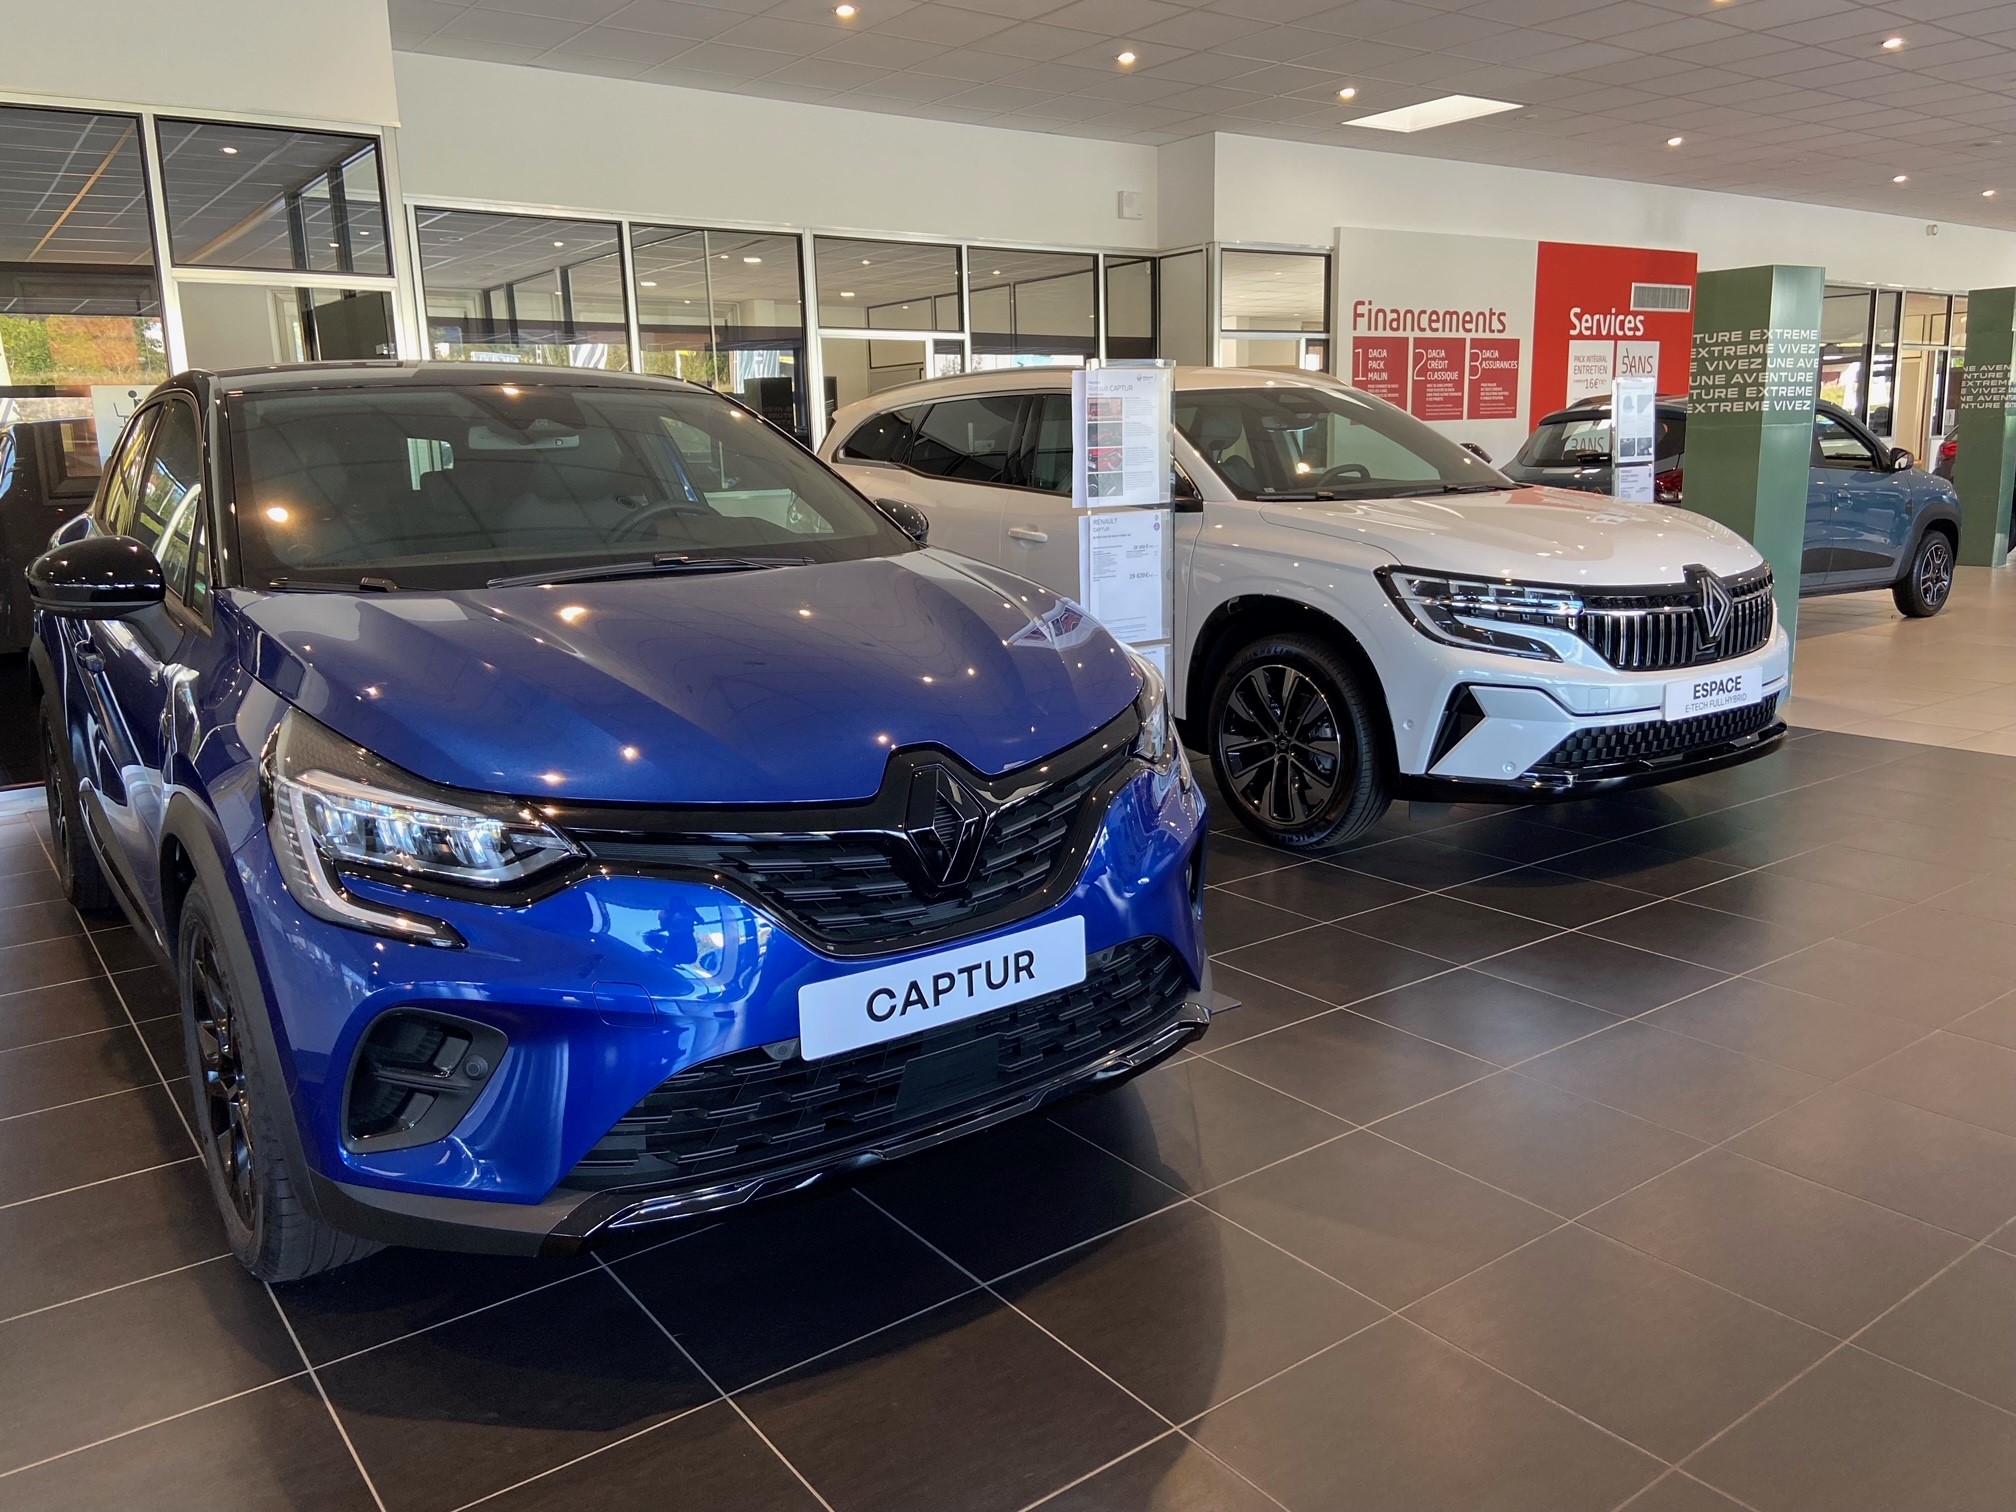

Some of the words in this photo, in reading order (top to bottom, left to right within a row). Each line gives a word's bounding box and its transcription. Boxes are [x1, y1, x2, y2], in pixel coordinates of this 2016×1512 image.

[1353, 299, 1507, 334] Financements
[1569, 307, 1644, 337] Services
[1750, 329, 1818, 341] EXTREME
[1368, 349, 1387, 358] DACIA
[1427, 349, 1445, 358] DACIA
[1482, 349, 1499, 358] DACIA
[1779, 343, 1816, 354] VIVEZ
[1354, 348, 1367, 381] 1
[1368, 360, 1384, 369] PACK
[1413, 349, 1427, 381] 2
[1427, 360, 1449, 369] CRÉDIT
[1469, 349, 1482, 380] 3
[1481, 360, 1518, 369] ASSURANCES
[1573, 355, 1586, 363] PACK
[1705, 358, 1762, 372] VIVEZ
[1767, 357, 1794, 369] UNE
[1573, 364, 1608, 376] ENTRETIEN
[1367, 372, 1388, 381] MALIN
[1426, 371, 1459, 382] CLASSIQUE
[1689, 374, 1726, 386] UNE
[1731, 372, 1813, 384] AVENTURE
[1109, 384, 1133, 392] CAPTUR
[1745, 386, 1813, 398] EXTREME
[1686, 400, 1769, 413] EXTREME
[1774, 400, 1811, 411] VIVEZ
[1092, 517, 1118, 526] RENAULT
[1693, 675, 1743, 700] ESPACE
[1685, 701, 1708, 714] E-TECH
[1709, 697, 1726, 709] FULL
[1725, 692, 1747, 705] HYBRID
[866, 949, 1036, 1023] CAPTUR
